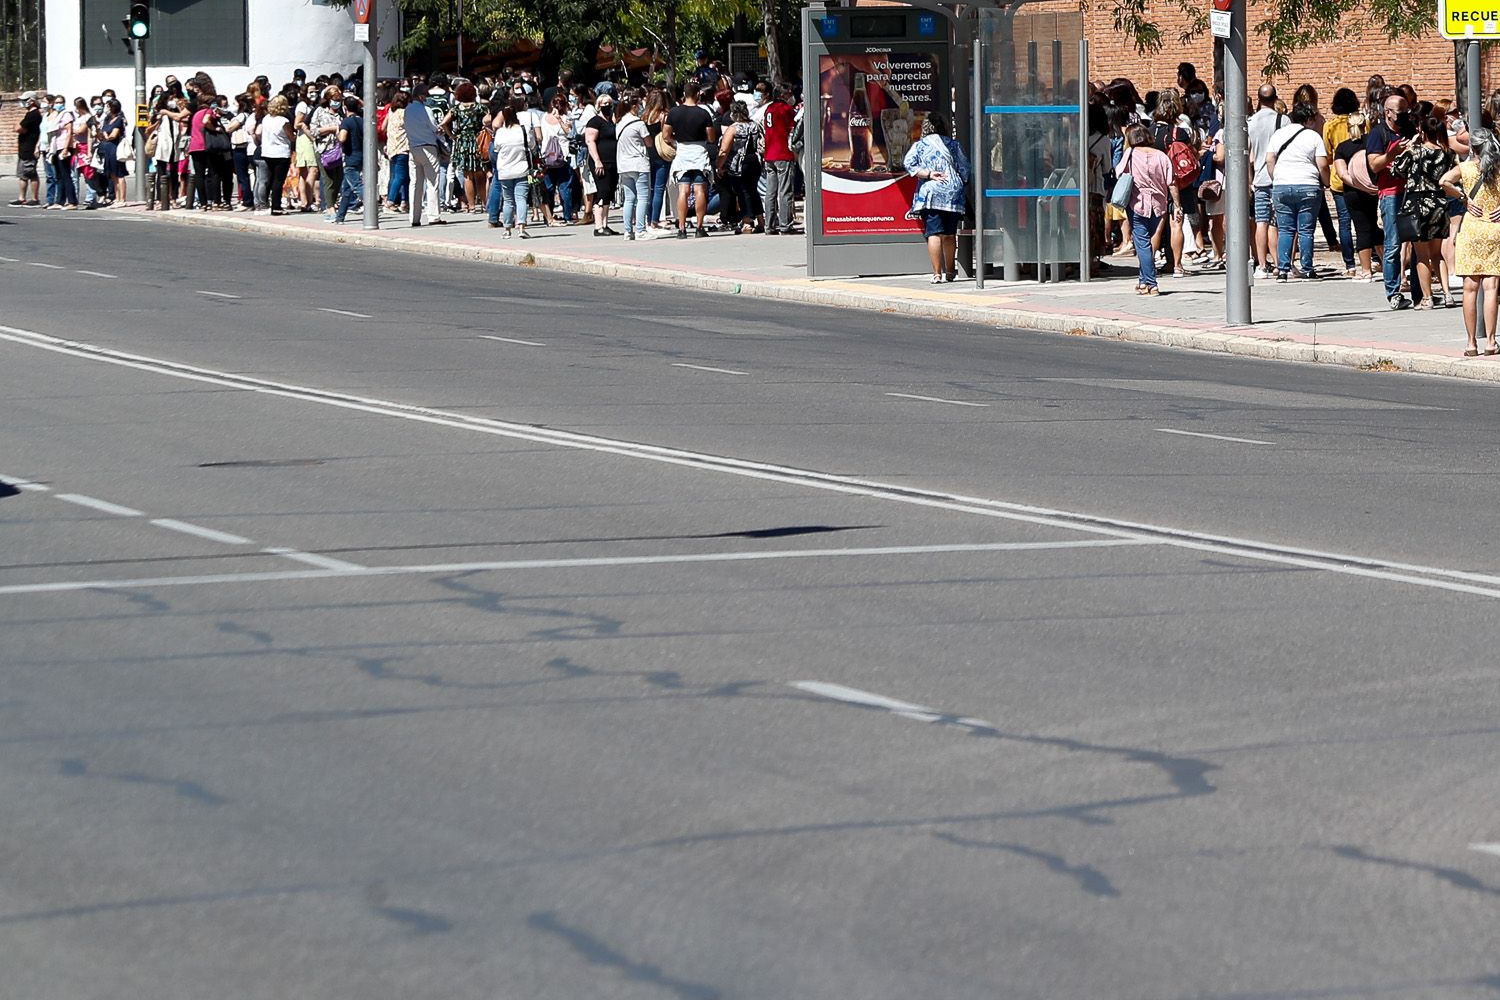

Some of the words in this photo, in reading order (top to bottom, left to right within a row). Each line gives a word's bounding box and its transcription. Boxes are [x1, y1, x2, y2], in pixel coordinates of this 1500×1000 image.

[873, 61, 932, 70] Volveremos
[866, 73, 889, 82] para
[891, 72, 932, 82] apreciar
[889, 83, 932, 91] nuestros
[902, 93, 932, 102] bares.
[766, 112, 773, 128] 9
